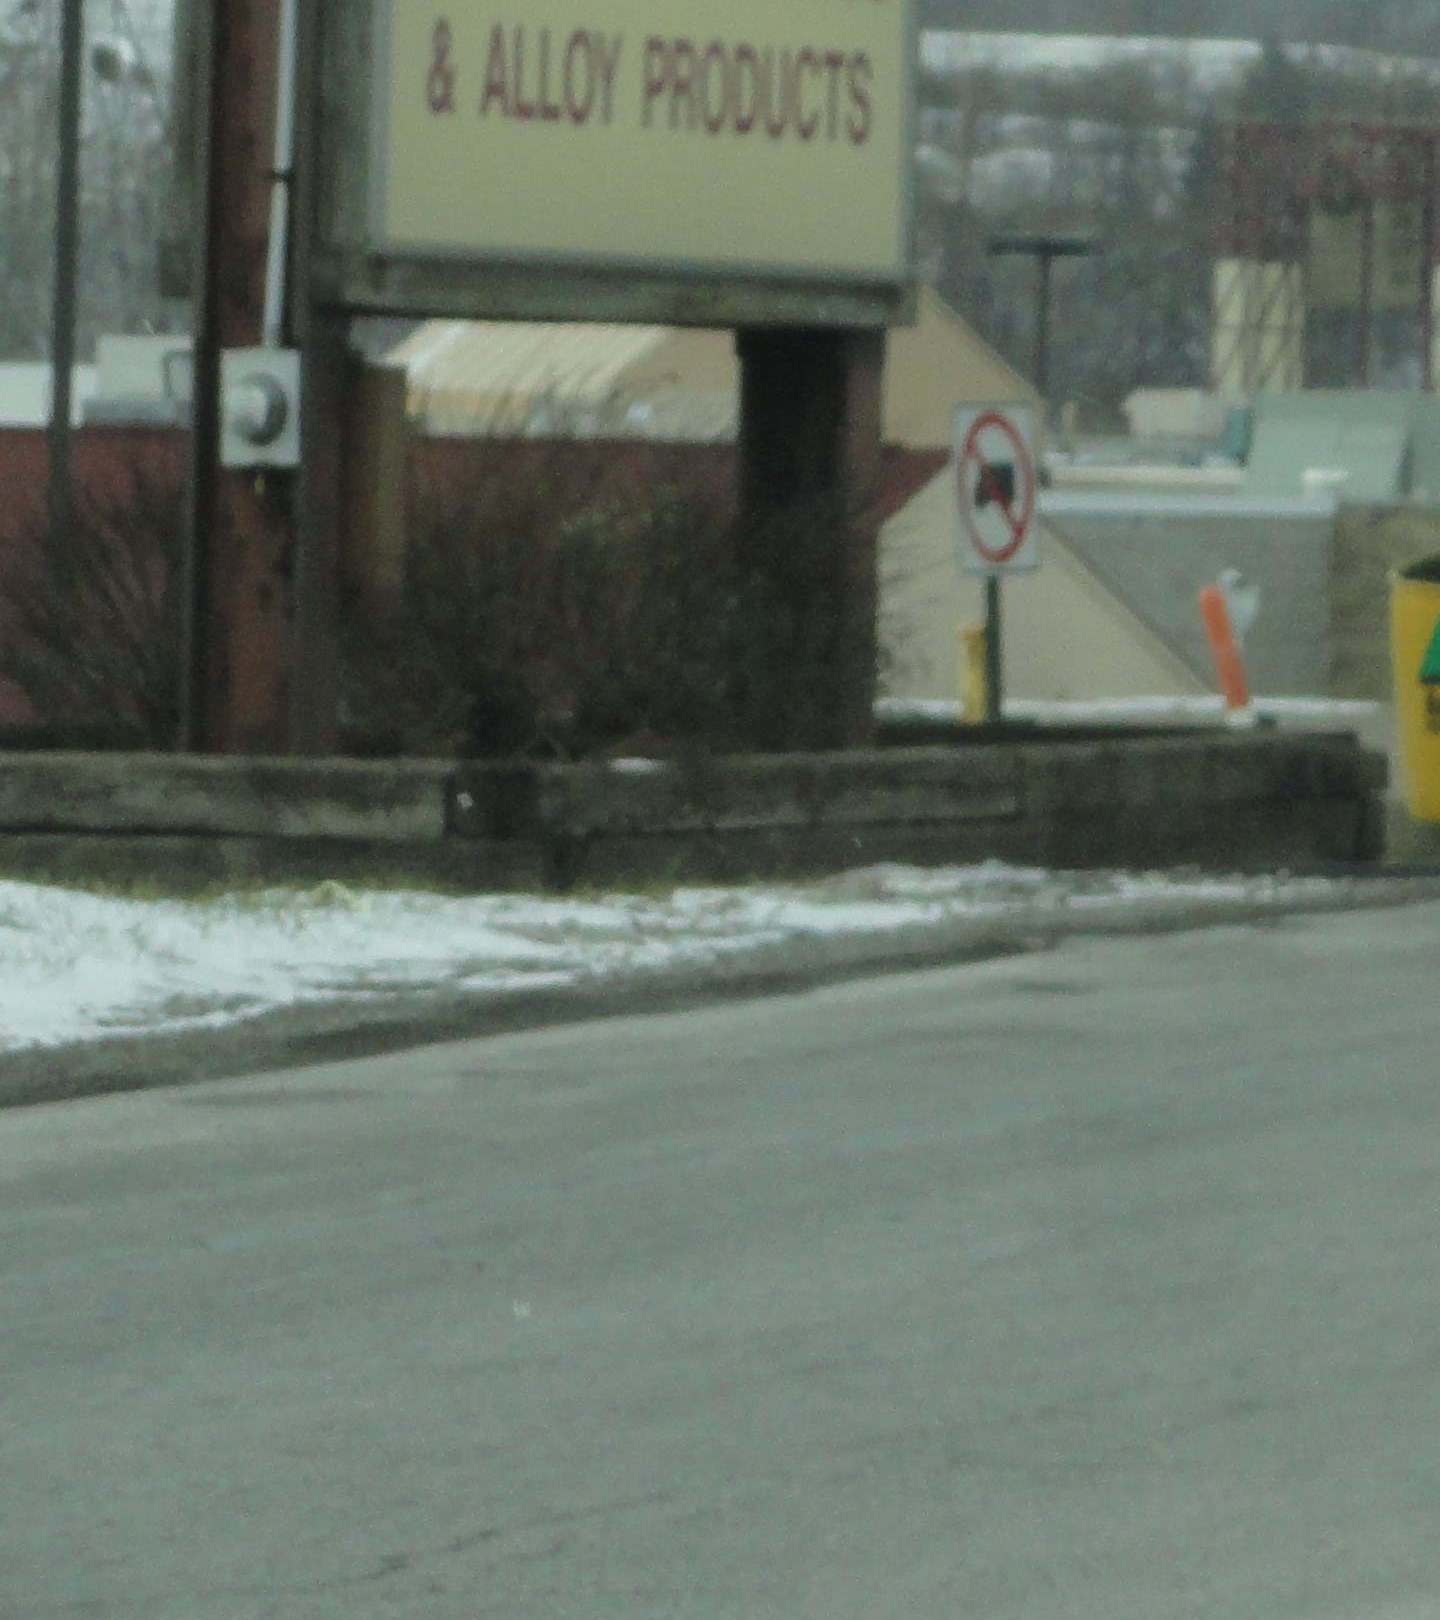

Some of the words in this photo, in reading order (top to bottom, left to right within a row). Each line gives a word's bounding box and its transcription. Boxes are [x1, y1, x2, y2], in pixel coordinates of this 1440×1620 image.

[426, 17, 457, 114] &
[481, 23, 624, 125] ALLOY
[640, 34, 874, 146] PRODUCTS
